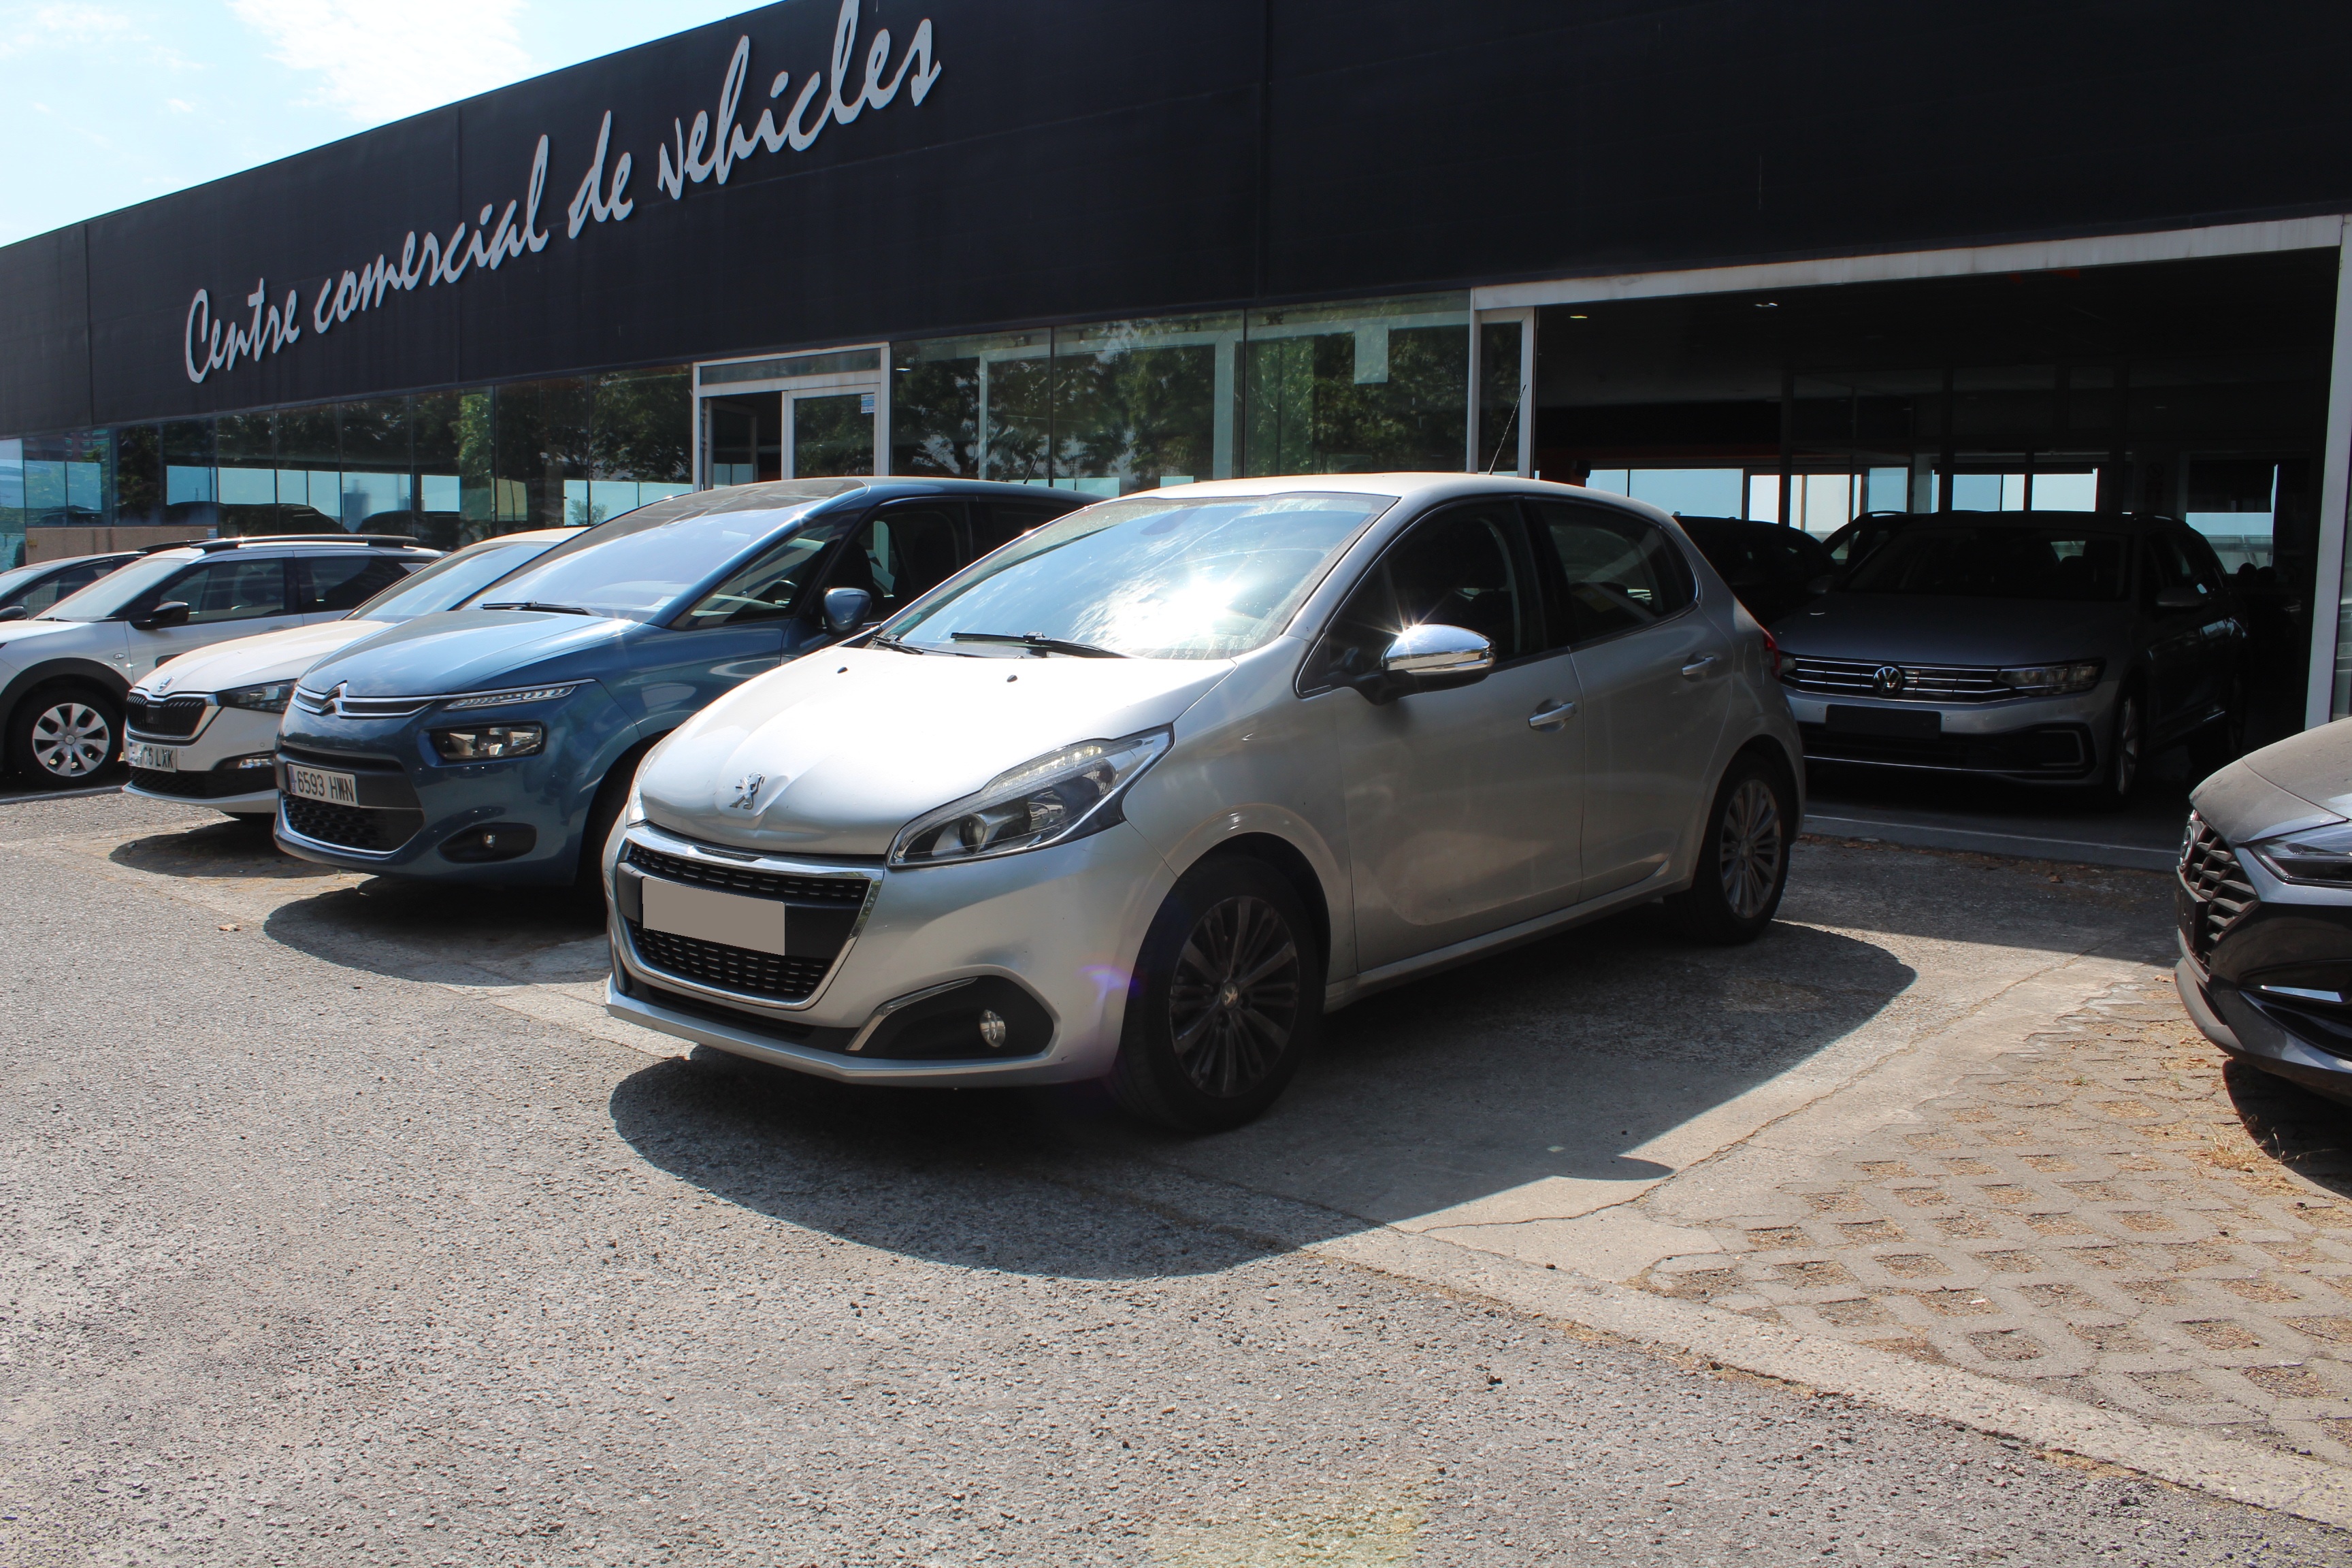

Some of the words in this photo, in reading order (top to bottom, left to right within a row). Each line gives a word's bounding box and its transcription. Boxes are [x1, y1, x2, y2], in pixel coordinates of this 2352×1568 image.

[185, 278, 299, 383] Centre
[314, 134, 549, 334] comercial
[568, 110, 633, 239] de
[657, 0, 941, 200] vehicles
[156, 748, 174, 768] LXK
[297, 770, 325, 797] 6593
[329, 776, 355, 802] HWN
